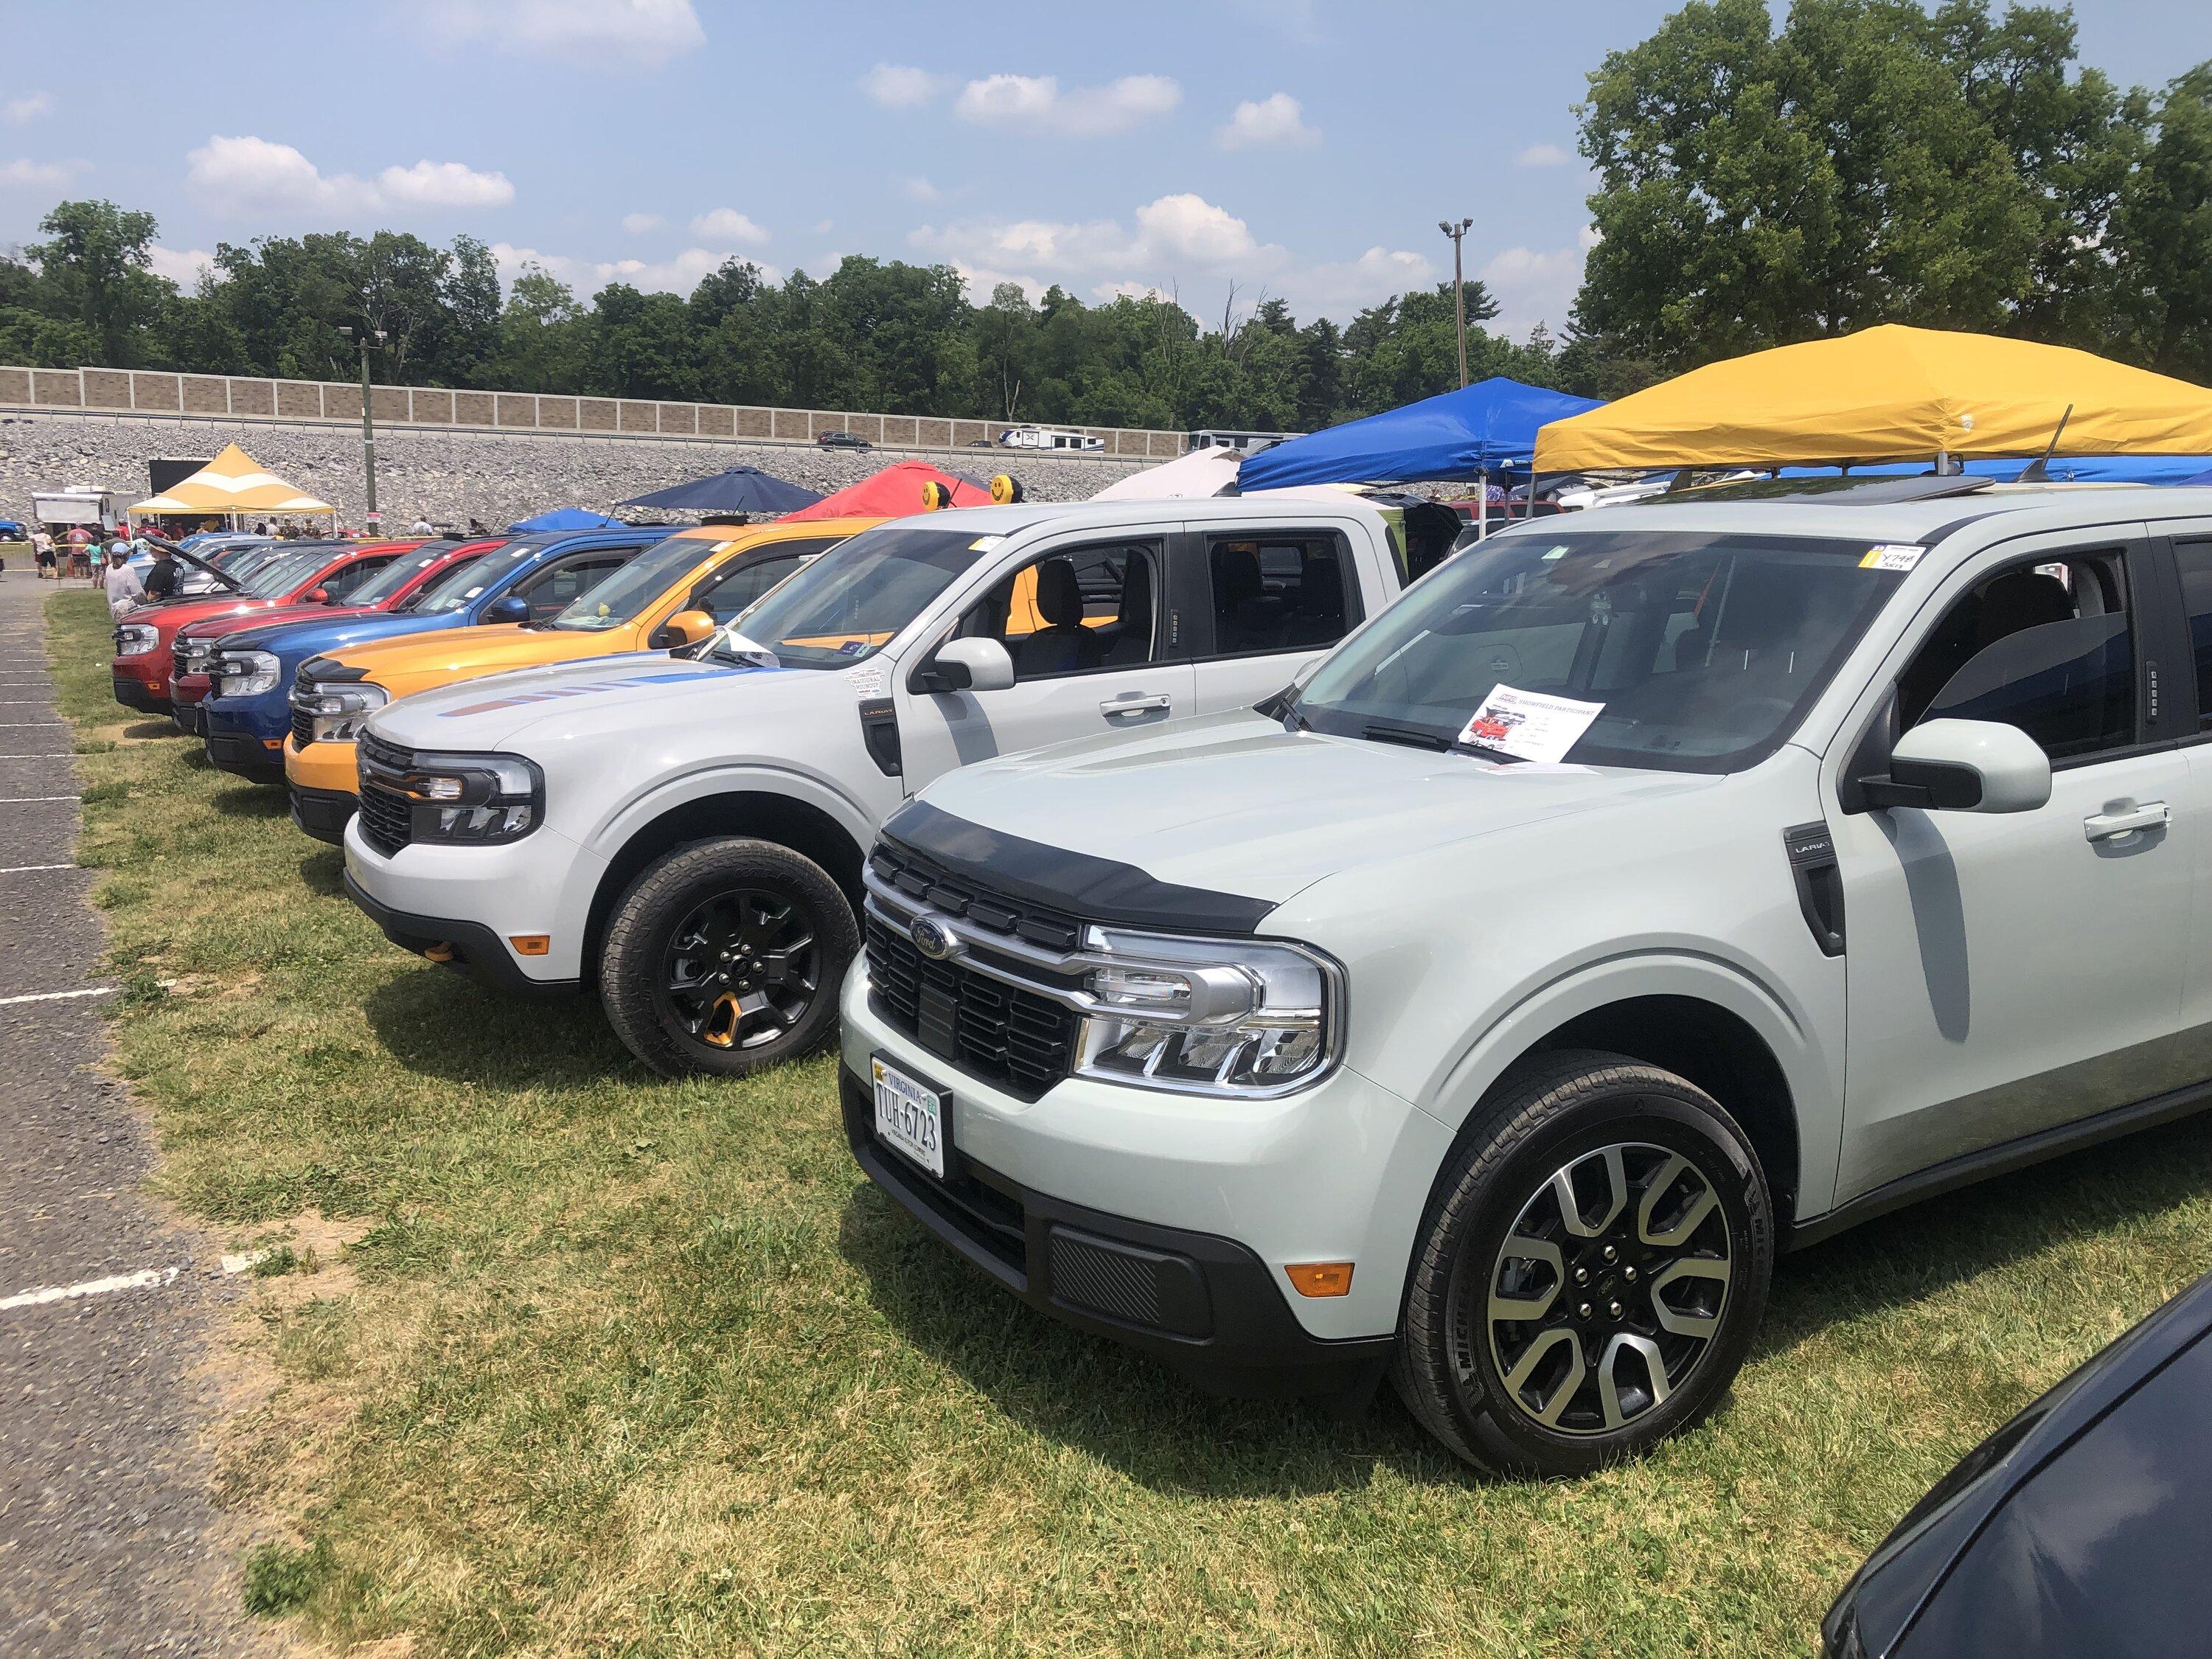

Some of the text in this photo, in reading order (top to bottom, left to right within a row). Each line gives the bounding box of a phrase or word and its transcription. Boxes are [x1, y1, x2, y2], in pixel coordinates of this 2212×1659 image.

[851, 676, 880, 685] INAUGURAL
[1518, 699, 1554, 709] SHOWFIELD
[1554, 706, 1596, 716] PARTICIPANT
[1795, 841, 1830, 853] LARIAT
[888, 1072, 922, 1105] VIRGINIA
[876, 1082, 937, 1152] TUH-6723
